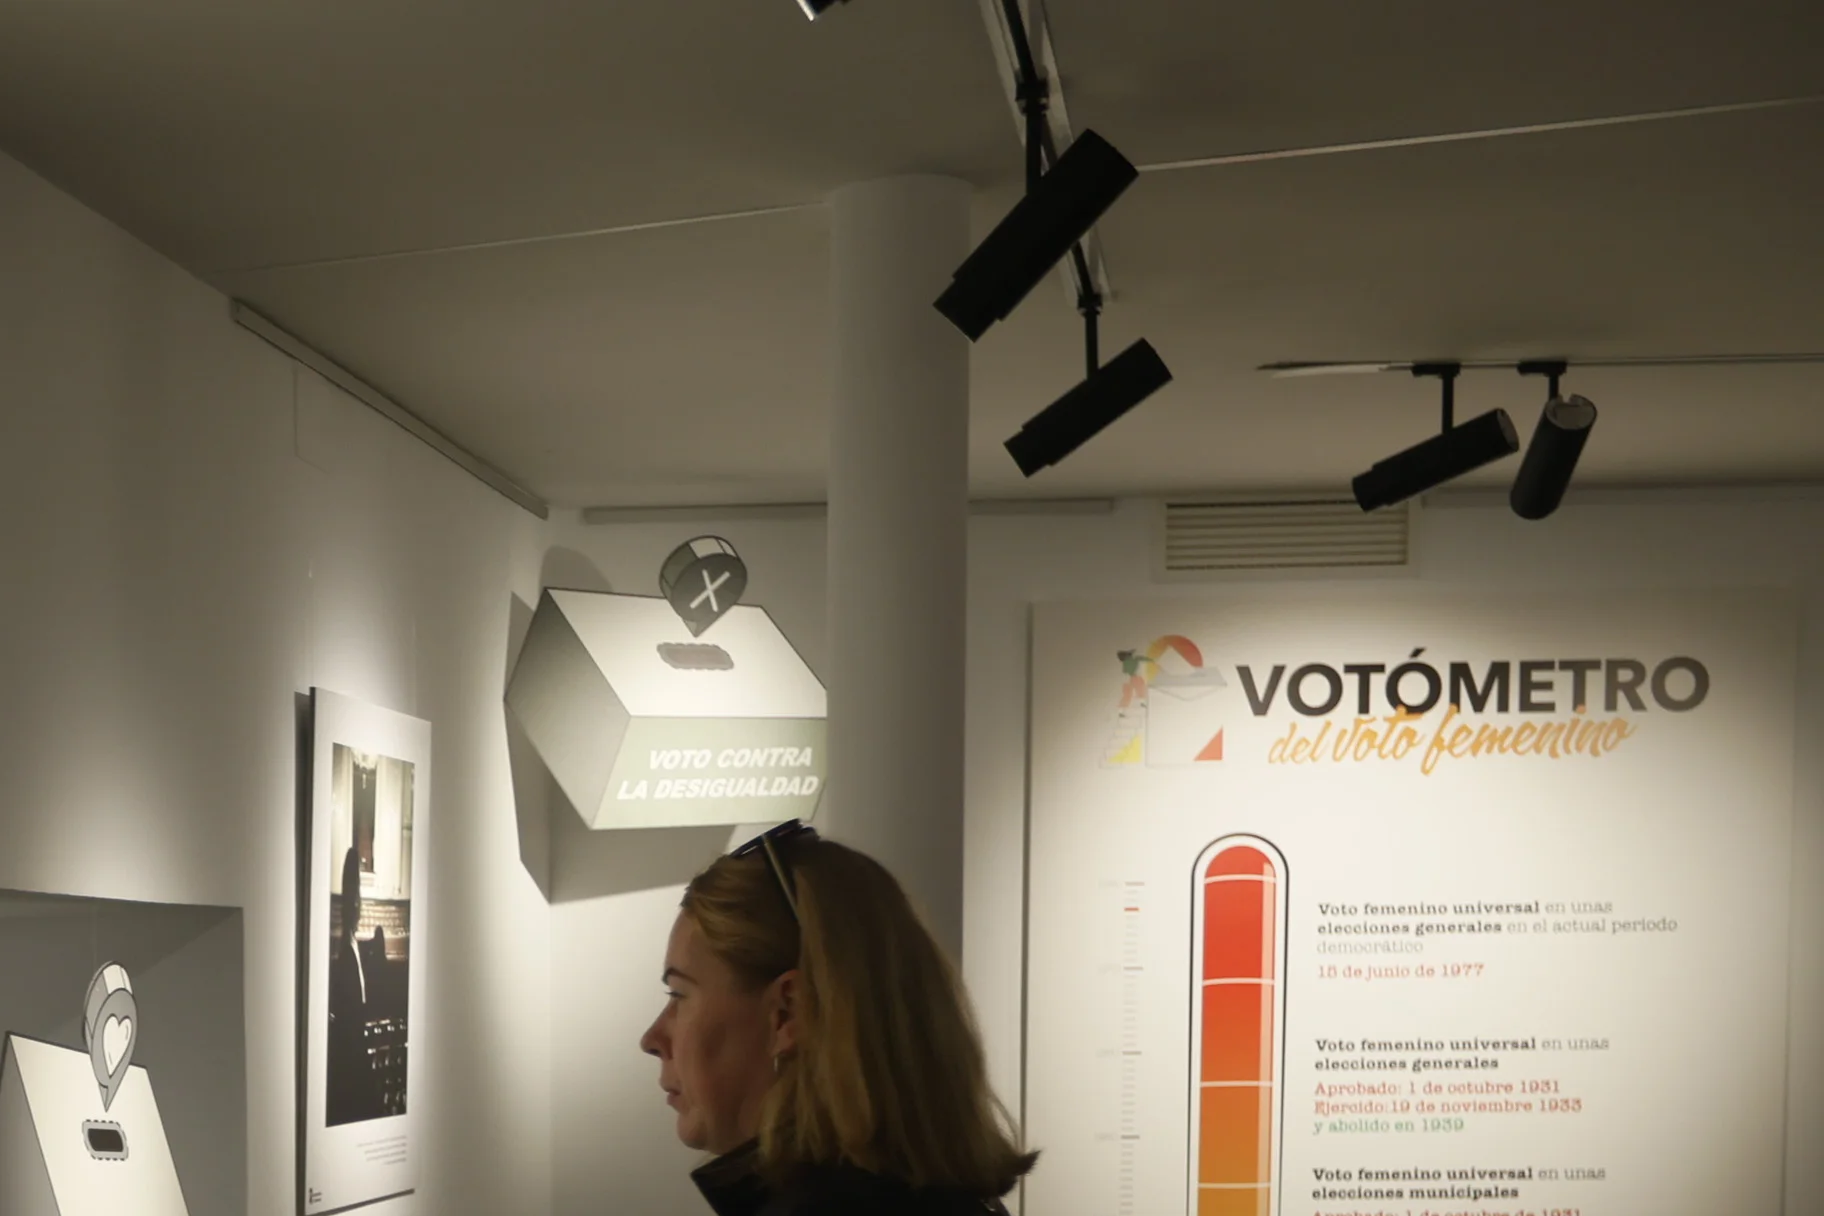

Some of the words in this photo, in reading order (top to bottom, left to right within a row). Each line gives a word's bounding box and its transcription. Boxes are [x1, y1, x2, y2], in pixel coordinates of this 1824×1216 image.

[1235, 647, 1711, 716] VOTÓMETRO
[1268, 719, 1332, 764] del
[1420, 704, 1639, 777] femenino
[649, 749, 711, 770] VOTO
[717, 747, 812, 769] CONTRA
[617, 780, 648, 800] LA
[654, 775, 819, 799] DESIGUALDAD
[1318, 903, 1358, 916] Voto
[1364, 901, 1448, 915] femenino
[1453, 899, 1539, 915] universal
[1545, 902, 1566, 914] en
[1571, 901, 1613, 914] unas
[1317, 922, 1410, 935] elecciones
[1415, 919, 1503, 936] generales
[1507, 922, 1527, 934] en
[1552, 918, 1606, 933] actual
[1342, 964, 1362, 978] de
[1366, 965, 1410, 981] junio
[1414, 964, 1436, 977] de
[1442, 962, 1485, 977] 1977
[1315, 1038, 1355, 1052] Voto
[1361, 1037, 1445, 1051] femenino
[1450, 1035, 1536, 1050] universal
[1541, 1038, 1563, 1050] en
[1314, 1058, 1407, 1071] elecciones
[1412, 1056, 1499, 1073] generales
[1314, 1081, 1401, 1097] Aprobado:
[1422, 1080, 1443, 1095] de
[1447, 1080, 1514, 1095] octubre
[1416, 1100, 1436, 1113] de
[1441, 1098, 1533, 1113] noviembre
[1313, 1121, 1324, 1135] y
[1328, 1119, 1390, 1133] abolido
[1394, 1120, 1415, 1132] en
[1312, 1167, 1353, 1181] Voto
[1358, 1166, 1442, 1181] femenino
[1447, 1165, 1533, 1181] universal
[1538, 1168, 1559, 1180] en
[1312, 1186, 1404, 1199] elecciones
[1409, 1184, 1519, 1201] municipales
